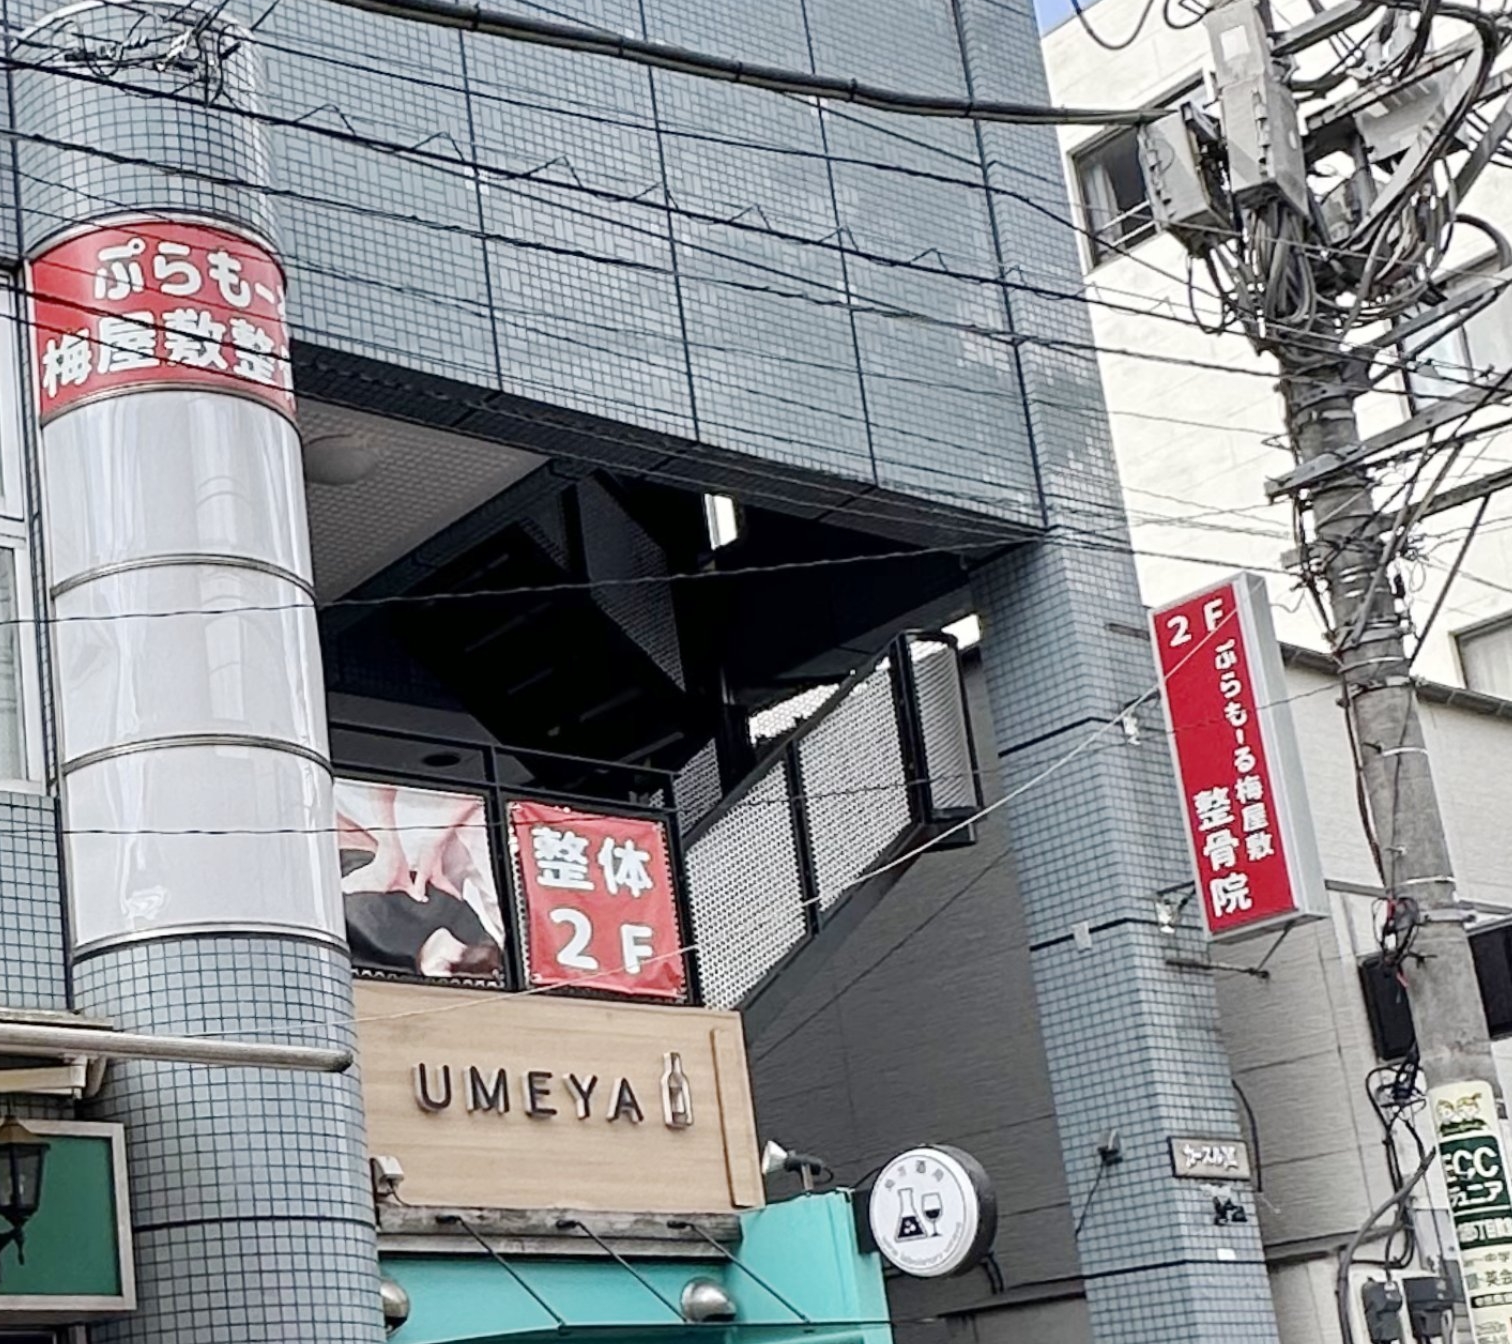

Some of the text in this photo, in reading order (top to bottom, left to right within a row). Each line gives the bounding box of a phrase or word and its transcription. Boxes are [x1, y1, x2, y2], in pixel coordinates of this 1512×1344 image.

[94, 237, 287, 322] ぷらもー
[43, 309, 294, 400] 梅屋敷整
[1166, 598, 1224, 647] 2F
[530, 825, 654, 898] 整体
[1192, 785, 1253, 919] 整骨院
[549, 906, 656, 976] 2F
[412, 1061, 645, 1125] UMEYA
